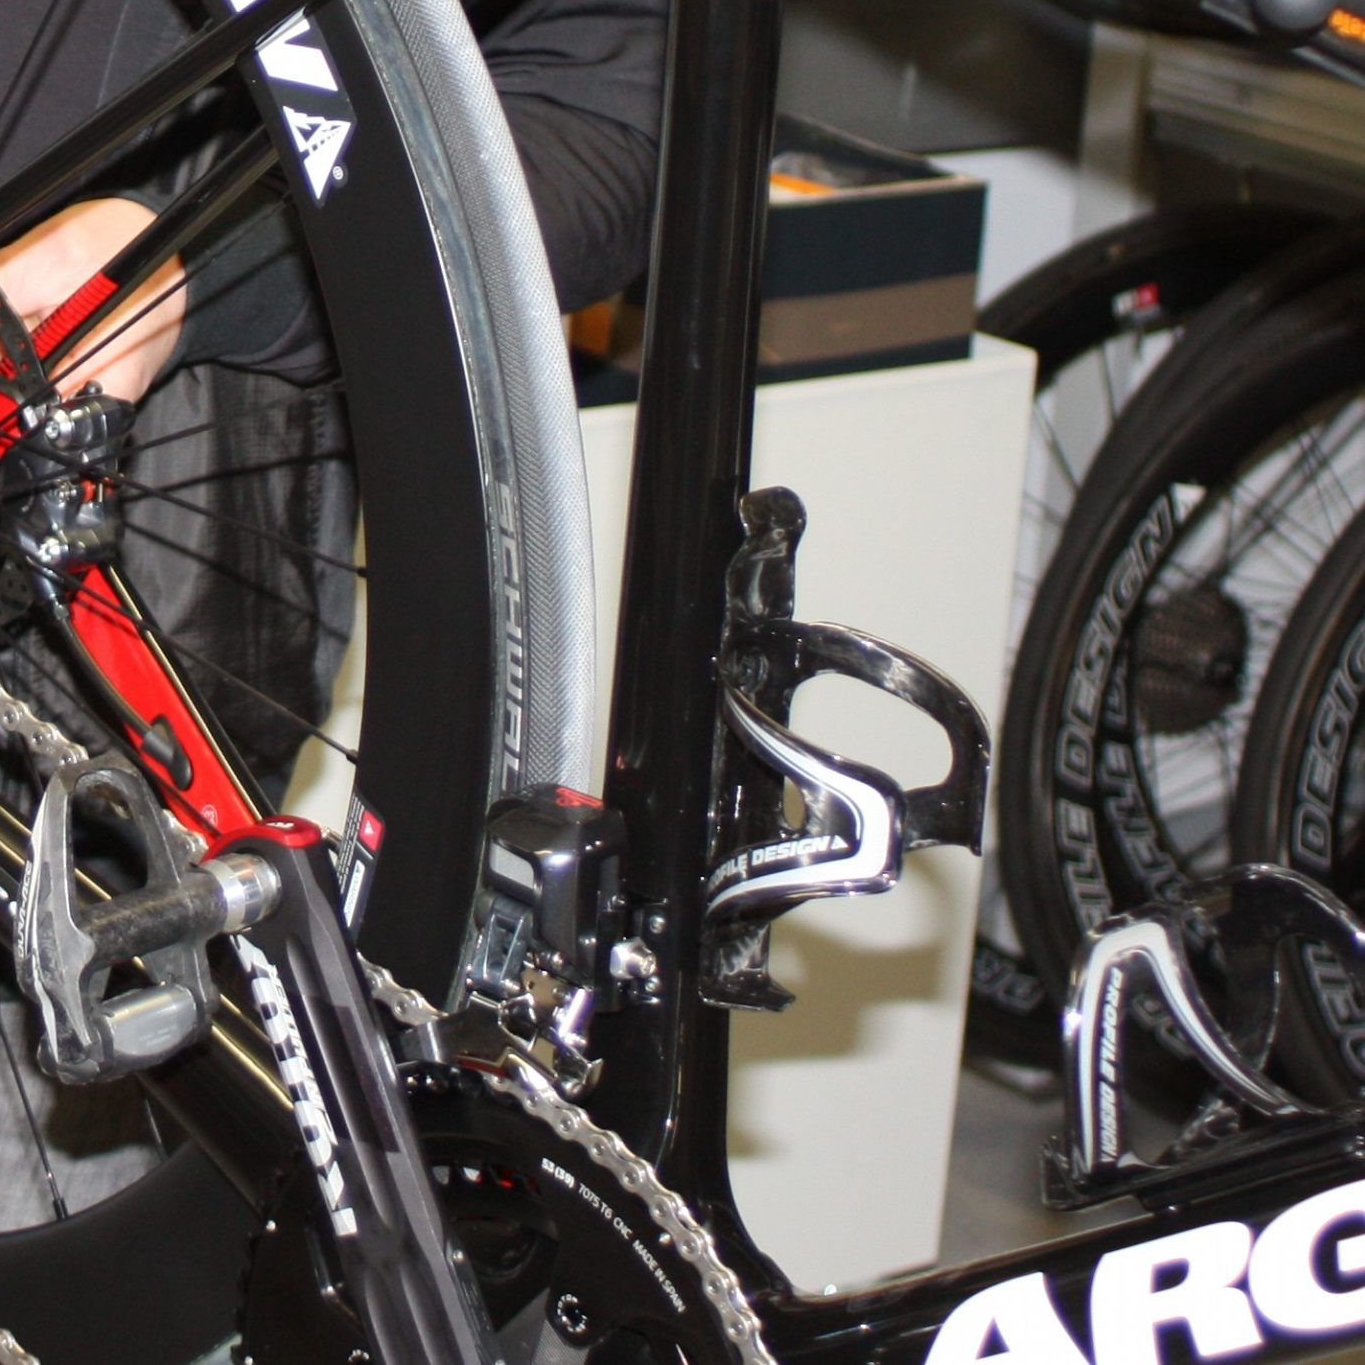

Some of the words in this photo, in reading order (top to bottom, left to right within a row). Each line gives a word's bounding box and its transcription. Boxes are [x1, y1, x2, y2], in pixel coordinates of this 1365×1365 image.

[751, 835, 832, 867] DESIGN
[1098, 966, 1123, 1082] PROFILE
[632, 1239, 660, 1271] MADE
[653, 1267, 667, 1283] IN
[661, 1279, 686, 1313] SPAIN
